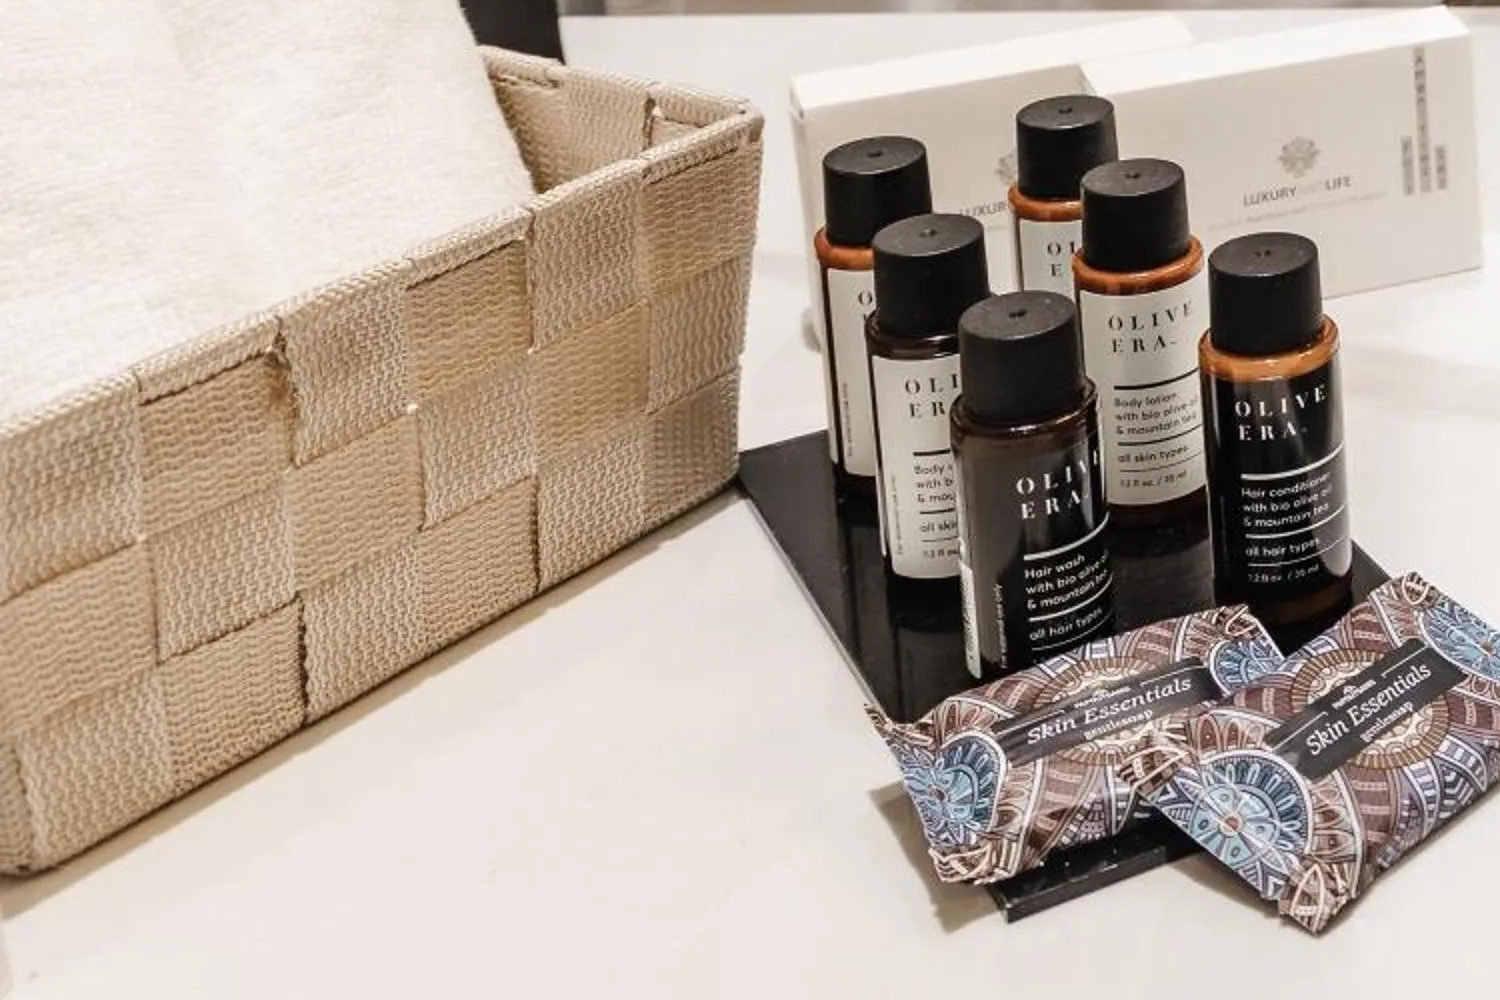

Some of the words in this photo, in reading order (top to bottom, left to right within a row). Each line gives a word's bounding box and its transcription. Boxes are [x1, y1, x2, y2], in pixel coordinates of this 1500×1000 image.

[1243, 186, 1298, 207] LUXURY
[1325, 175, 1352, 191] LIFE
[960, 201, 1007, 217] UXUR
[1107, 301, 1193, 331] OLIVE
[1111, 335, 1166, 353] ERA
[905, 373, 959, 395] OLI
[909, 401, 946, 419] ER
[1114, 397, 1142, 409] Body
[1145, 392, 1177, 406] lotion
[1235, 383, 1328, 417] OLIVE
[1115, 411, 1139, 421] with
[1127, 417, 1181, 435] mountain
[1238, 421, 1297, 441] ERA
[1242, 487, 1266, 499] Hair
[1021, 489, 1081, 519] ERA
[1243, 503, 1267, 513] with
[1255, 511, 1311, 527] mountain
[1024, 567, 1053, 579] Hair
[1055, 553, 1086, 573] wash
[1025, 581, 1054, 595] with
[1057, 574, 1078, 589] bio
[1040, 580, 1096, 608] mountain
[1028, 628, 1046, 641] all
[1027, 719, 1077, 745] Skin
[1084, 677, 1193, 725] Essentials
[1305, 719, 1350, 756] Skin
[1346, 664, 1432, 727] Essentials
